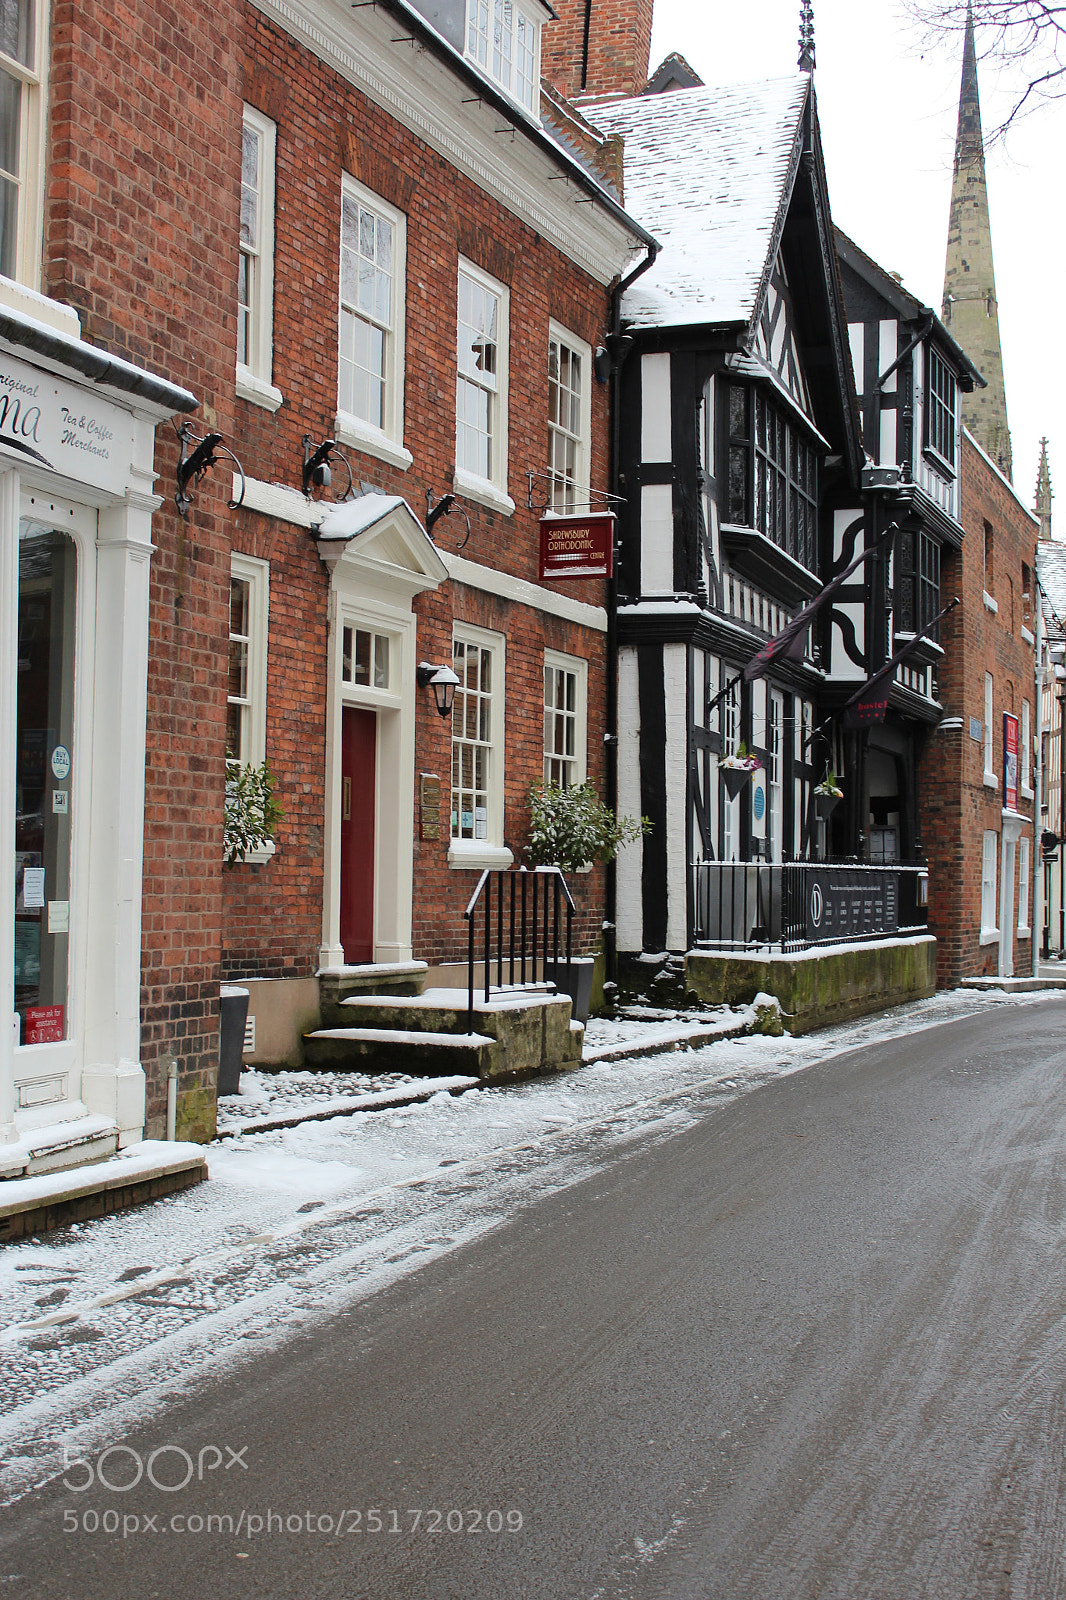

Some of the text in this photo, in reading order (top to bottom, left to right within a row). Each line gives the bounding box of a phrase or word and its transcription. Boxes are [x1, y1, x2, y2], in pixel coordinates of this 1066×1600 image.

[61, 407, 114, 441] Tea & Coffee
[61, 429, 110, 459] Merchants
[548, 529, 590, 541] SHREWSBURY
[548, 540, 594, 551] ORTHODONTIC
[858, 700, 887, 710] hostel
[53, 757, 69, 766] LOCAL
